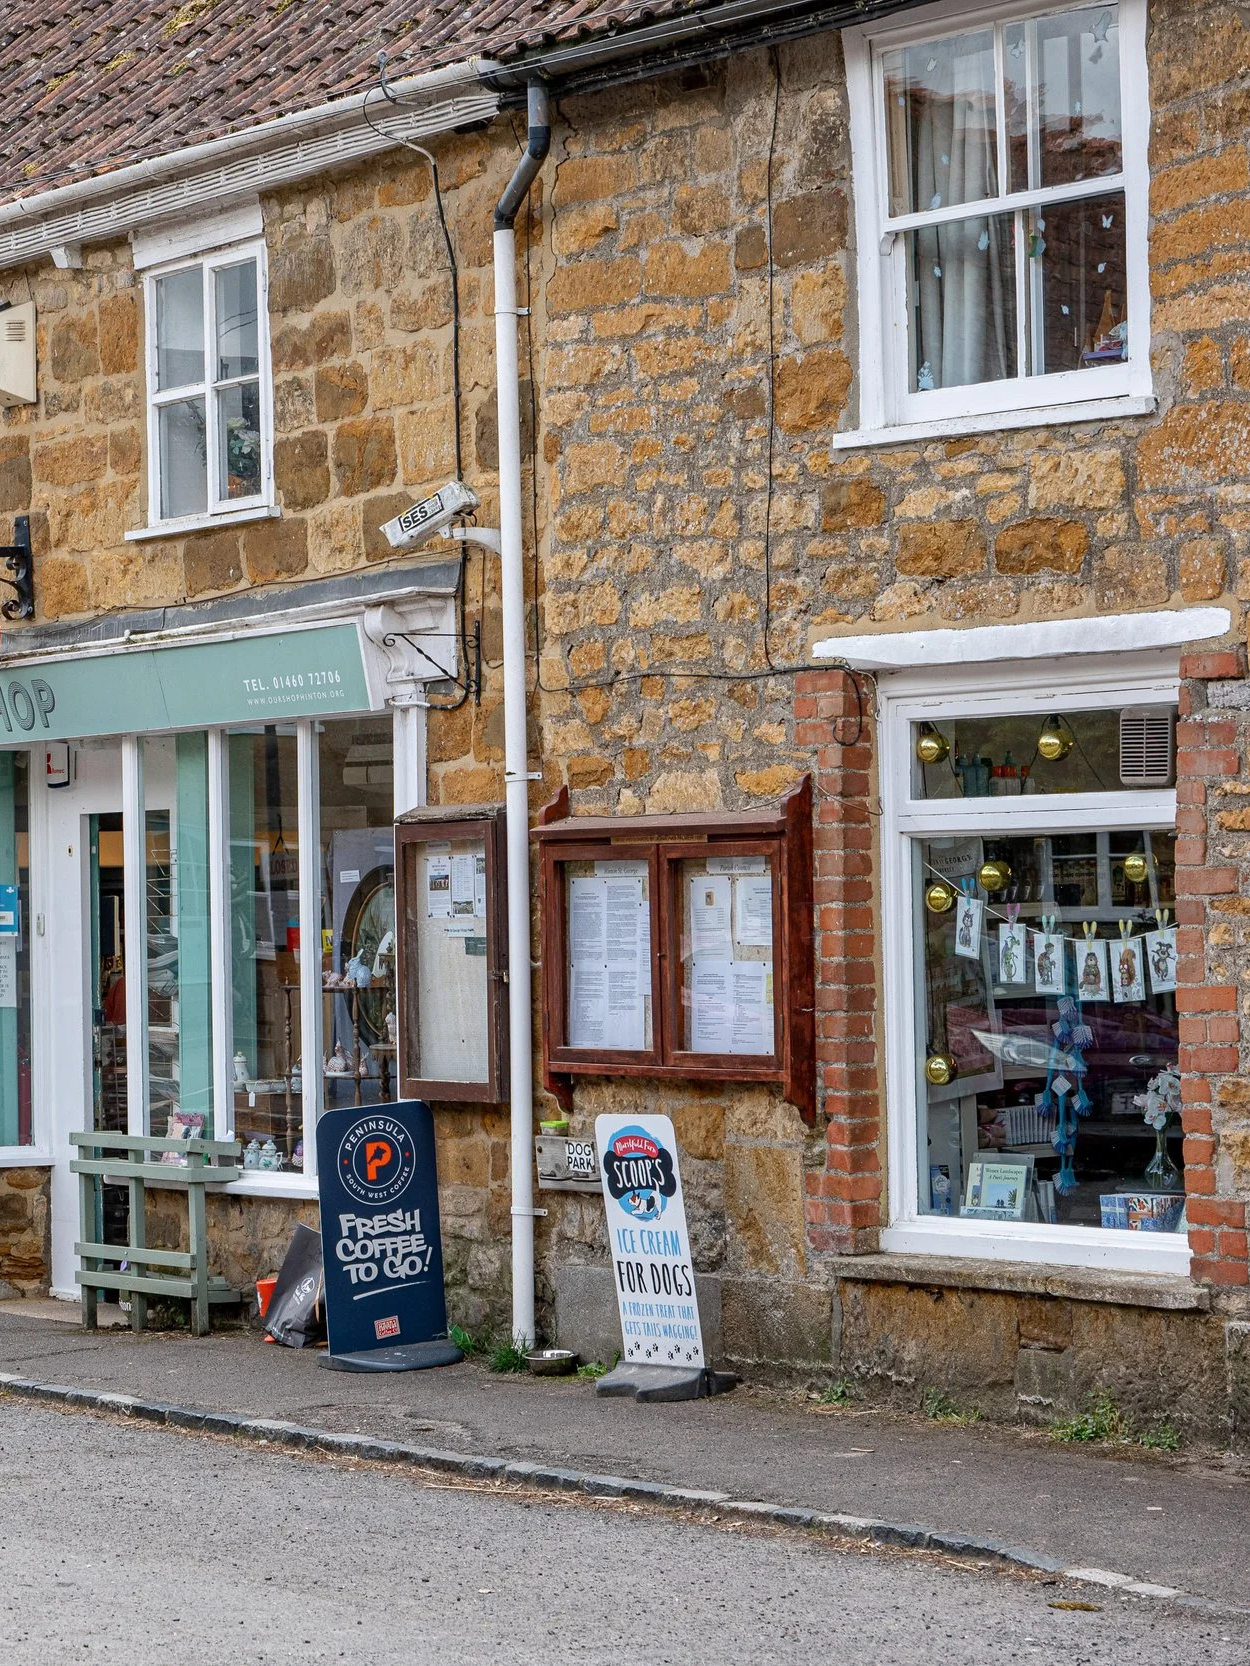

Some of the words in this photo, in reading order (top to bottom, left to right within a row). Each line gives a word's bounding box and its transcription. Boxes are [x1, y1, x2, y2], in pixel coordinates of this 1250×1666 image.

[402, 506, 428, 528] SES
[243, 679, 269, 692] TEL.
[273, 674, 303, 689] 01460
[308, 670, 341, 685] 72706
[247, 689, 345, 706] WWW.OURSHOPHINTON.ORG
[345, 1120, 405, 1151] PENINSULA
[567, 1142, 591, 1156] DOG
[567, 1156, 593, 1171] PARK
[613, 1158, 665, 1188] SCOOP'S
[346, 1173, 366, 1196] SOUTH
[368, 1190, 387, 1199] WEST
[390, 1166, 410, 1193] COFFEE
[339, 1208, 420, 1239] FRESH
[335, 1233, 427, 1263] COFFEE
[617, 1228, 637, 1255] ICE
[640, 1229, 682, 1257] CREAM
[343, 1263, 378, 1284] TO
[383, 1246, 432, 1279] GO!
[617, 1260, 648, 1294] FOR
[651, 1263, 692, 1297] DOGS
[622, 1301, 627, 1316] A
[628, 1302, 654, 1317] FROZEN
[655, 1304, 675, 1320] TREAT
[678, 1305, 695, 1320] THAT
[625, 1320, 642, 1336] GETS
[643, 1321, 662, 1337] TAILS
[662, 1321, 698, 1340] WAGGING!
